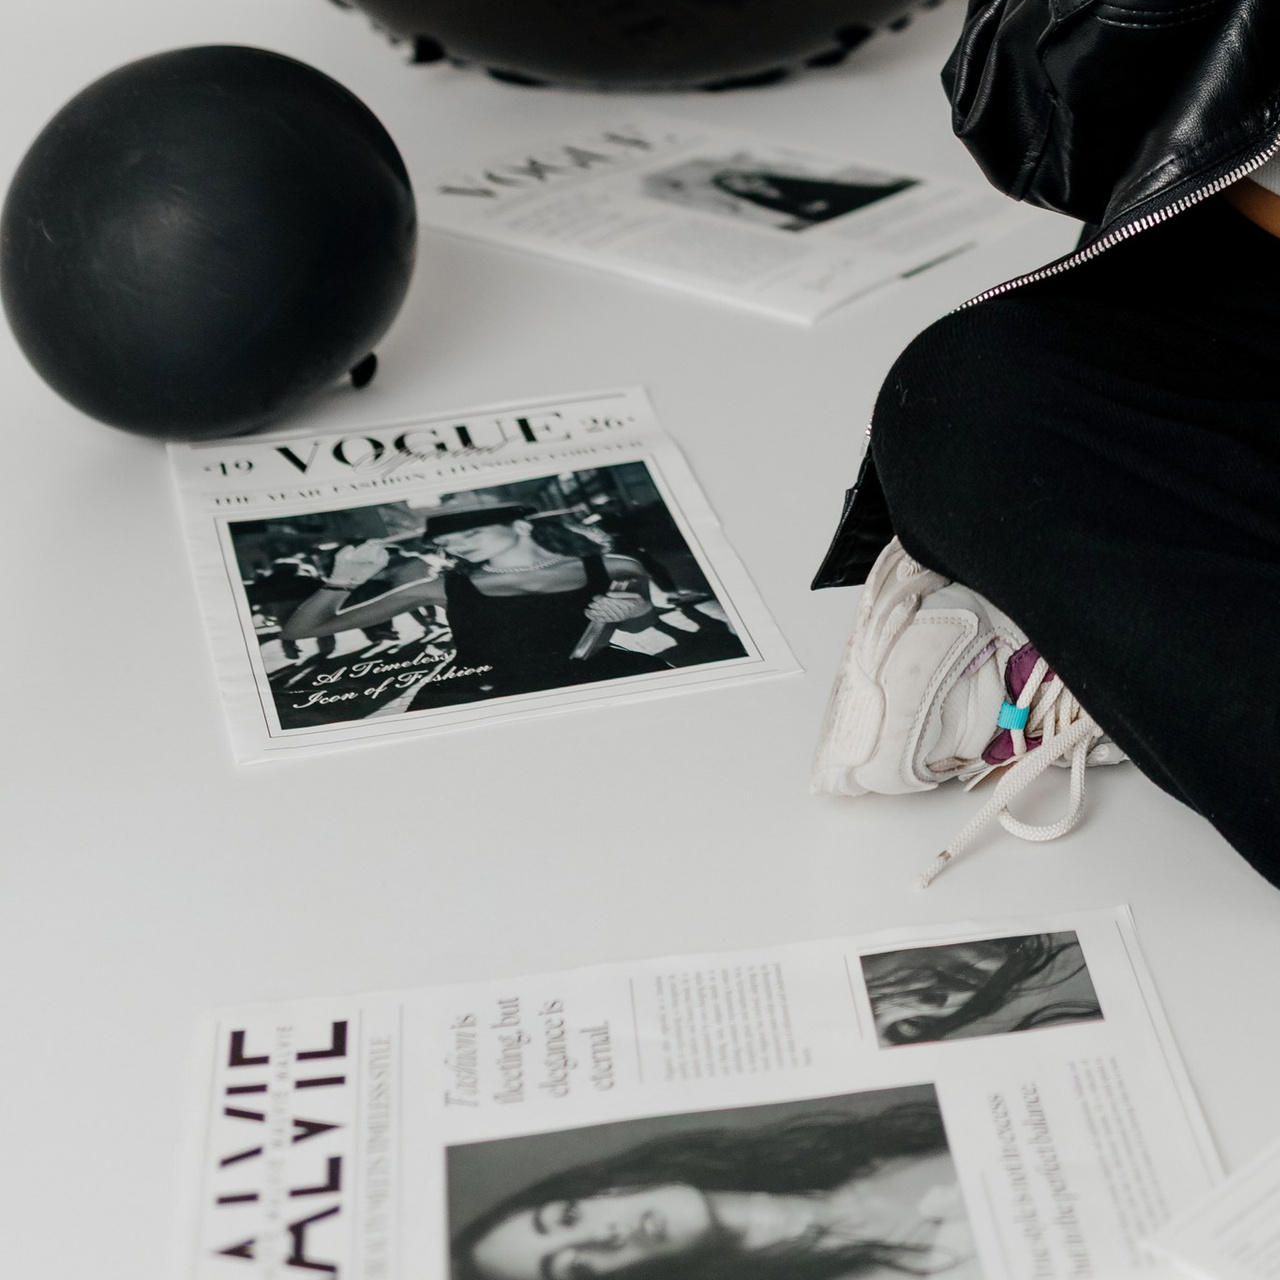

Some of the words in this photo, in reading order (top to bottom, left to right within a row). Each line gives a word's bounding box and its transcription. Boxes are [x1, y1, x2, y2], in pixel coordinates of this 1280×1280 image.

[274, 411, 572, 475] VOGUE
[292, 689, 359, 709] Icon
[364, 676, 395, 699] of
[395, 664, 494, 689] Fashion
[312, 666, 348, 686] A
[349, 650, 451, 678] Timeless
